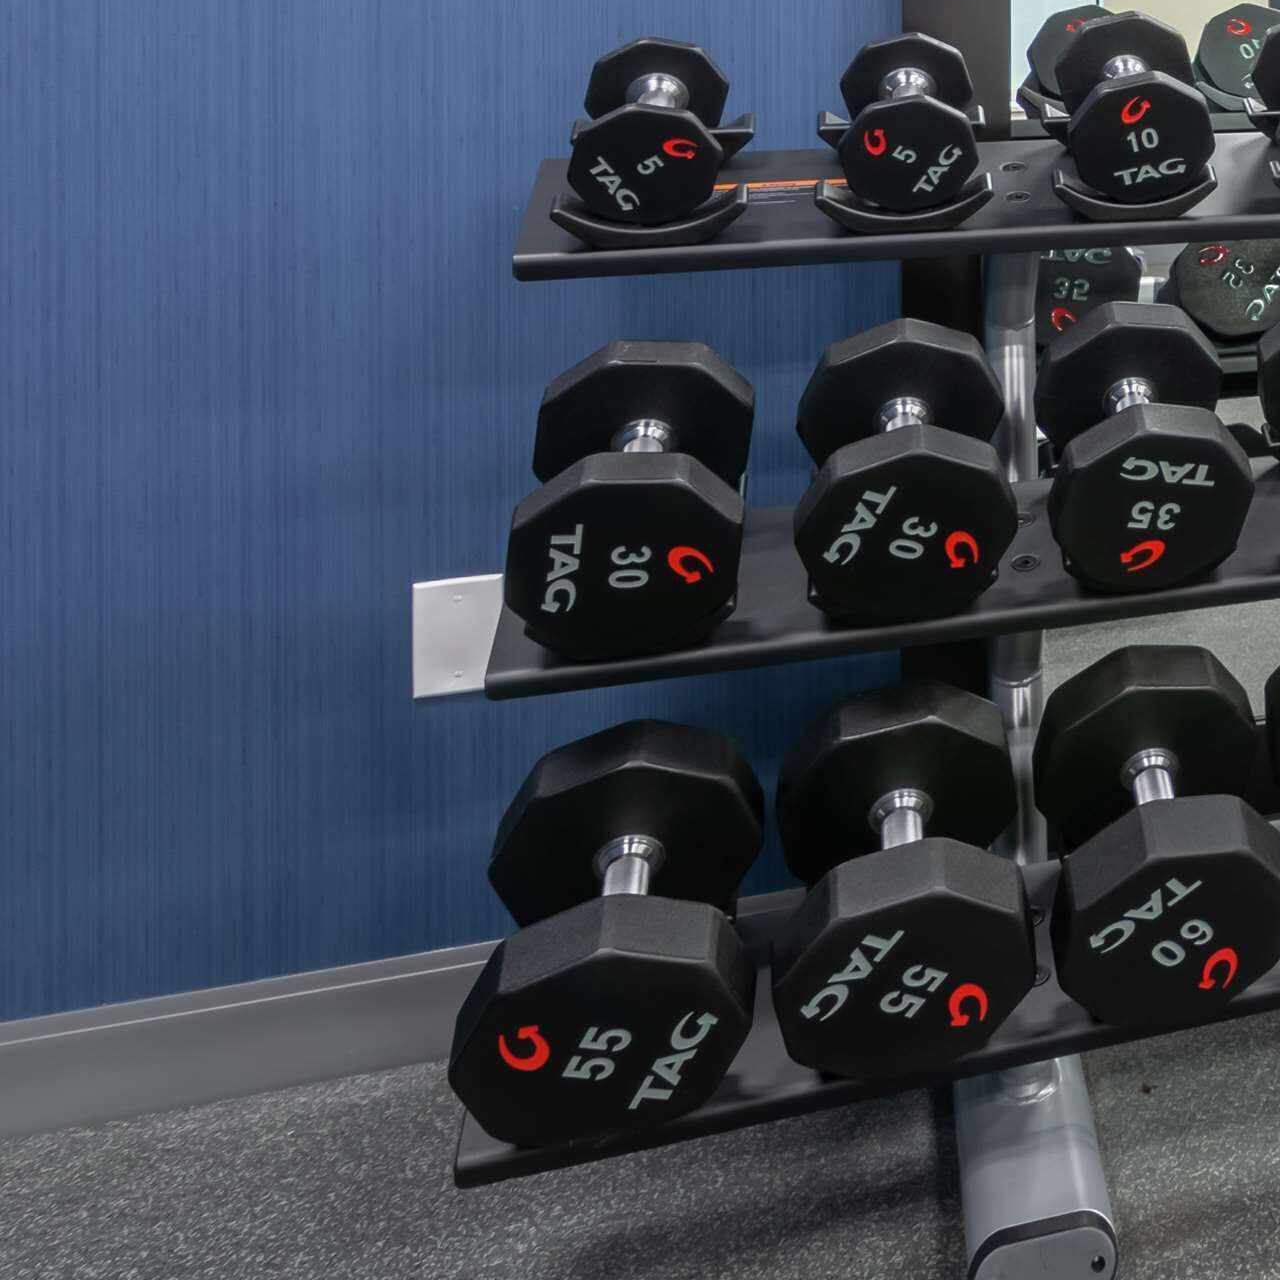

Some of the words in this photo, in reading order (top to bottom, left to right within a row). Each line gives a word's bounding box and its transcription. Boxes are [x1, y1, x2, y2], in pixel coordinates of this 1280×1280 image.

[891, 145, 917, 164] 5
[1126, 127, 1159, 153] 10
[589, 156, 640, 211] TAG
[636, 155, 665, 175] 5
[912, 144, 963, 193] TAG
[1113, 157, 1187, 186] TAG
[1119, 456, 1215, 487] TAG
[823, 486, 897, 565] TAG
[889, 516, 938, 560] 30
[1127, 500, 1181, 530] 35
[540, 524, 584, 613] TAG
[608, 545, 652, 589] 30
[1089, 877, 1203, 954] TAG
[1151, 919, 1214, 967] 60
[800, 930, 905, 1022] TAG
[879, 964, 949, 1018] 55
[562, 1027, 632, 1081] 55
[628, 1011, 719, 1109] TAG
